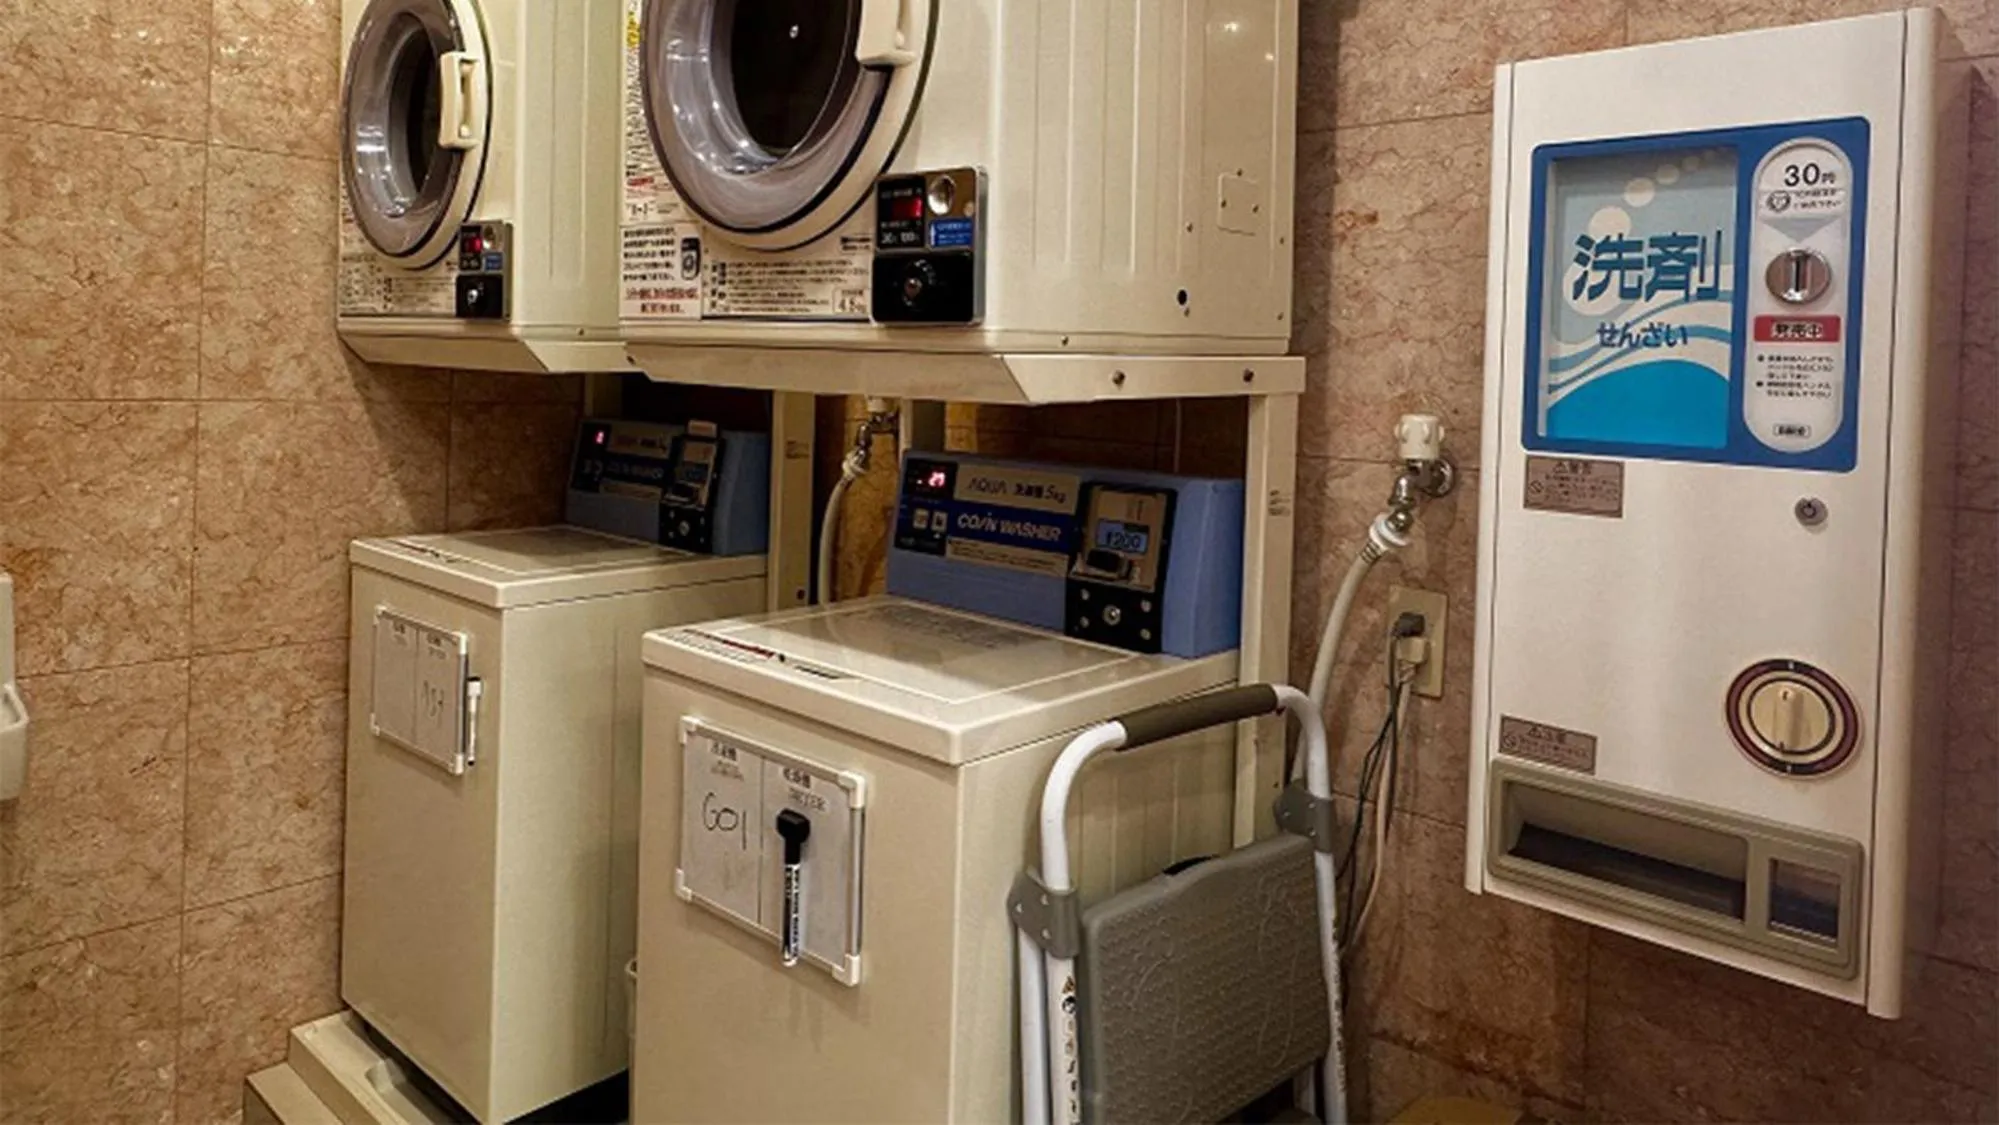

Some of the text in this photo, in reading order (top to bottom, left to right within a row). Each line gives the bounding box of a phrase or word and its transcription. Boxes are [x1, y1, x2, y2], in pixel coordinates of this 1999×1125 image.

[1572, 230, 1724, 302] 洗剤
[1596, 322, 1689, 349] せんざい
[1000, 519, 1062, 542] WASHER
